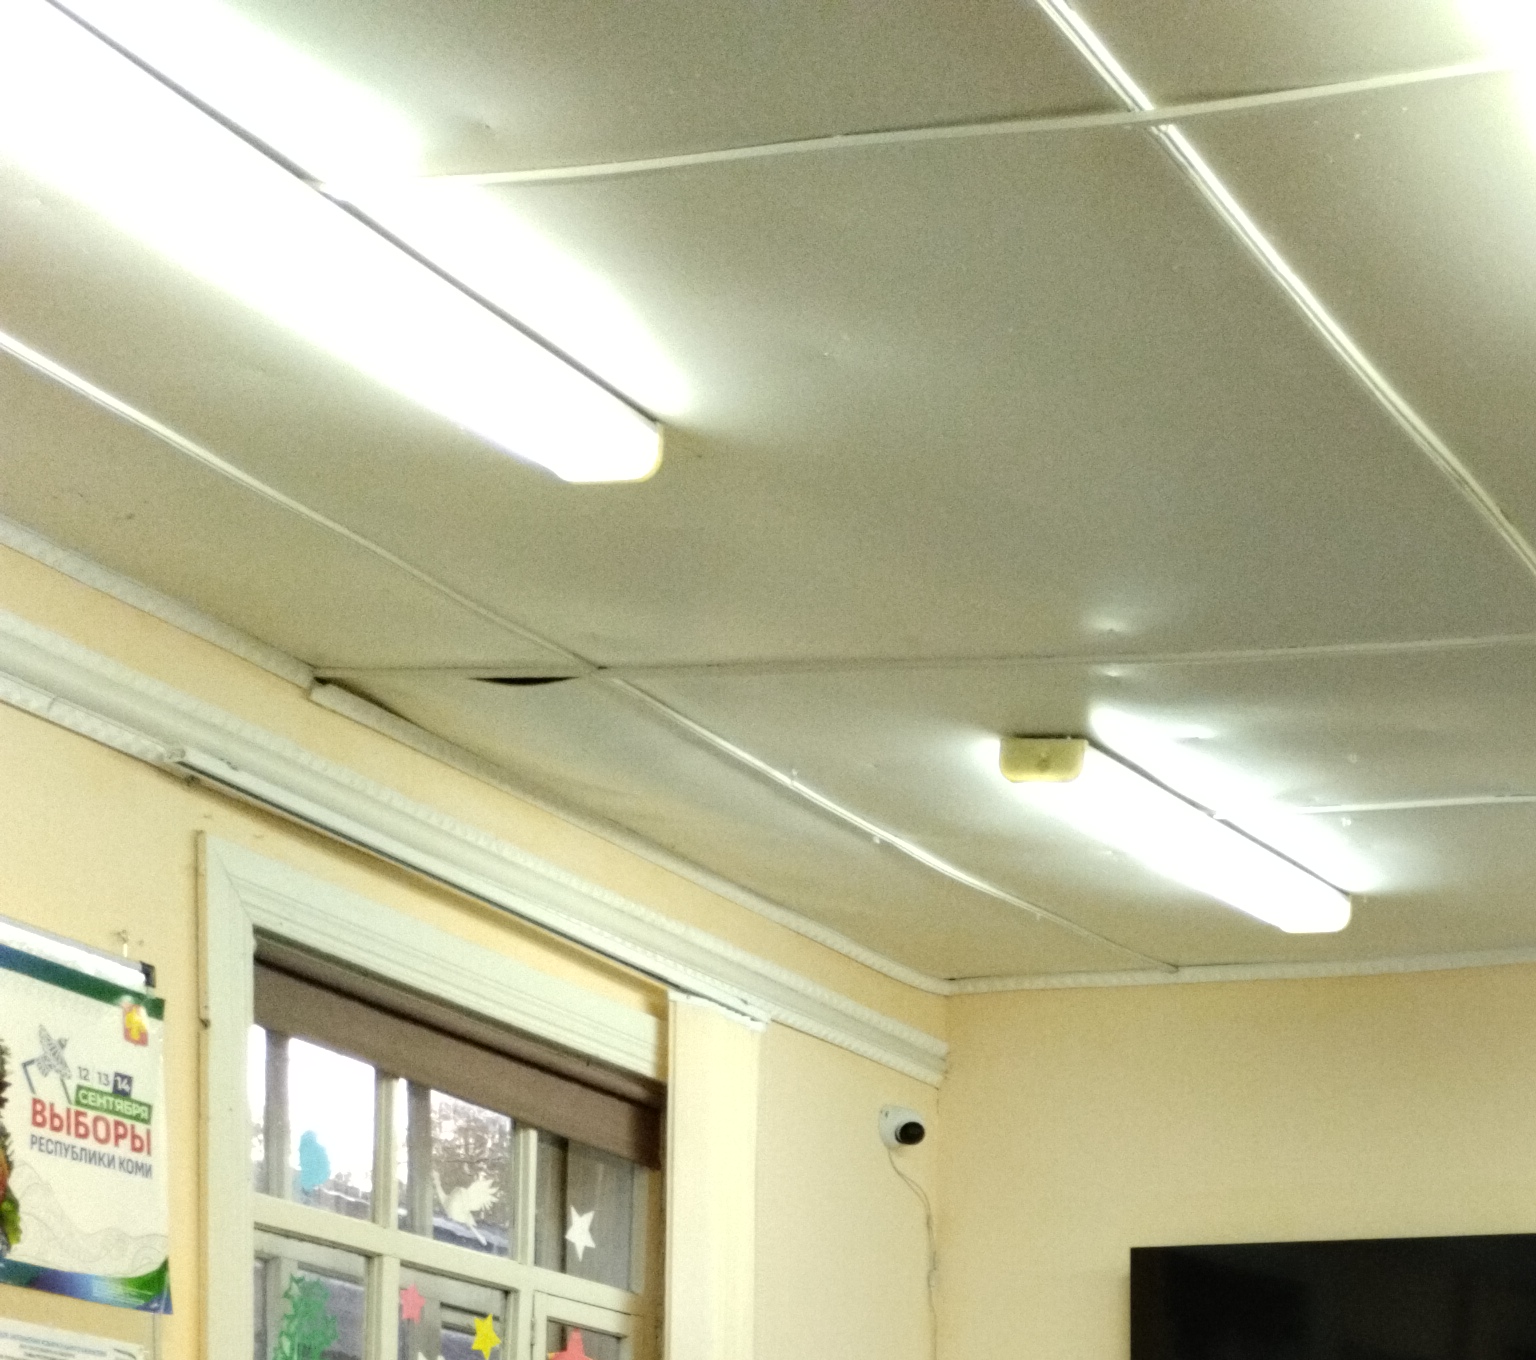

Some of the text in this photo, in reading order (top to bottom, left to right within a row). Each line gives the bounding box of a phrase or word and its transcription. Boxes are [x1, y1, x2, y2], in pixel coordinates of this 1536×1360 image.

[78, 1066, 131, 1093] 12 13 14
[77, 1089, 149, 1120] СЕНТЯБРЯ
[31, 1096, 152, 1157] ВЫБОРЫ
[30, 1133, 153, 1180] РЕСПУБЛИКИ КОМИ
